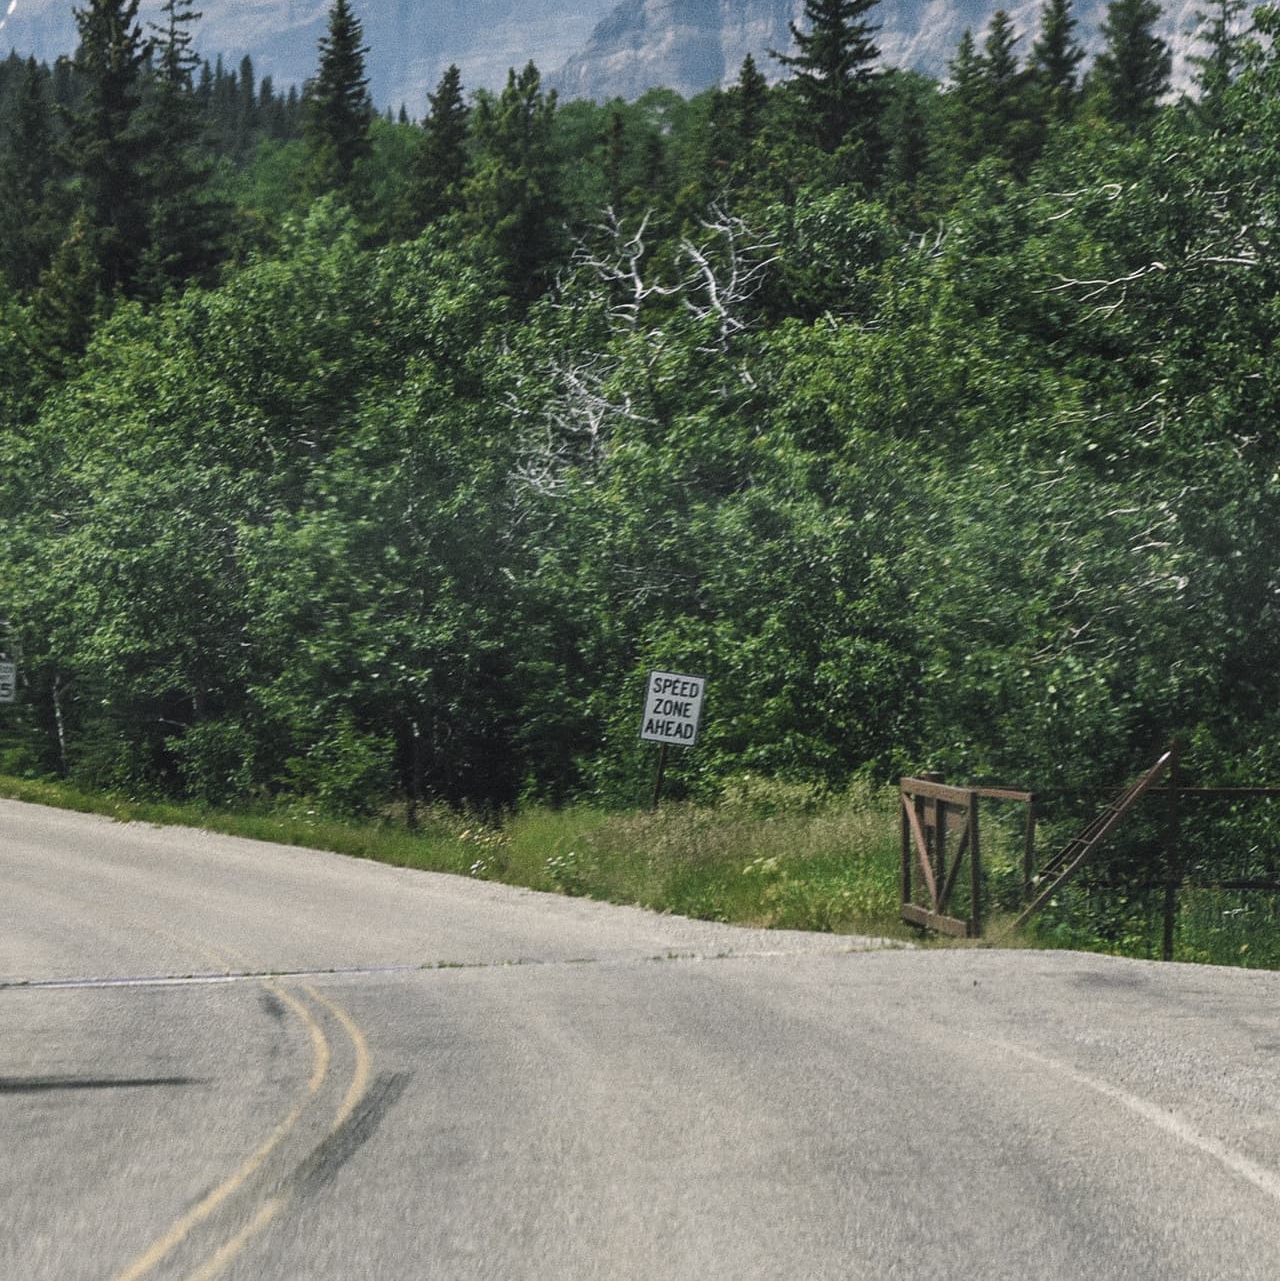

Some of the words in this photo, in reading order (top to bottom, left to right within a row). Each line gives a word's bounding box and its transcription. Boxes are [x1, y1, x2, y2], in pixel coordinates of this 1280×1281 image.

[653, 678, 699, 698] SPEED
[653, 698, 693, 718] ZONE
[644, 718, 694, 739] AHEAD
